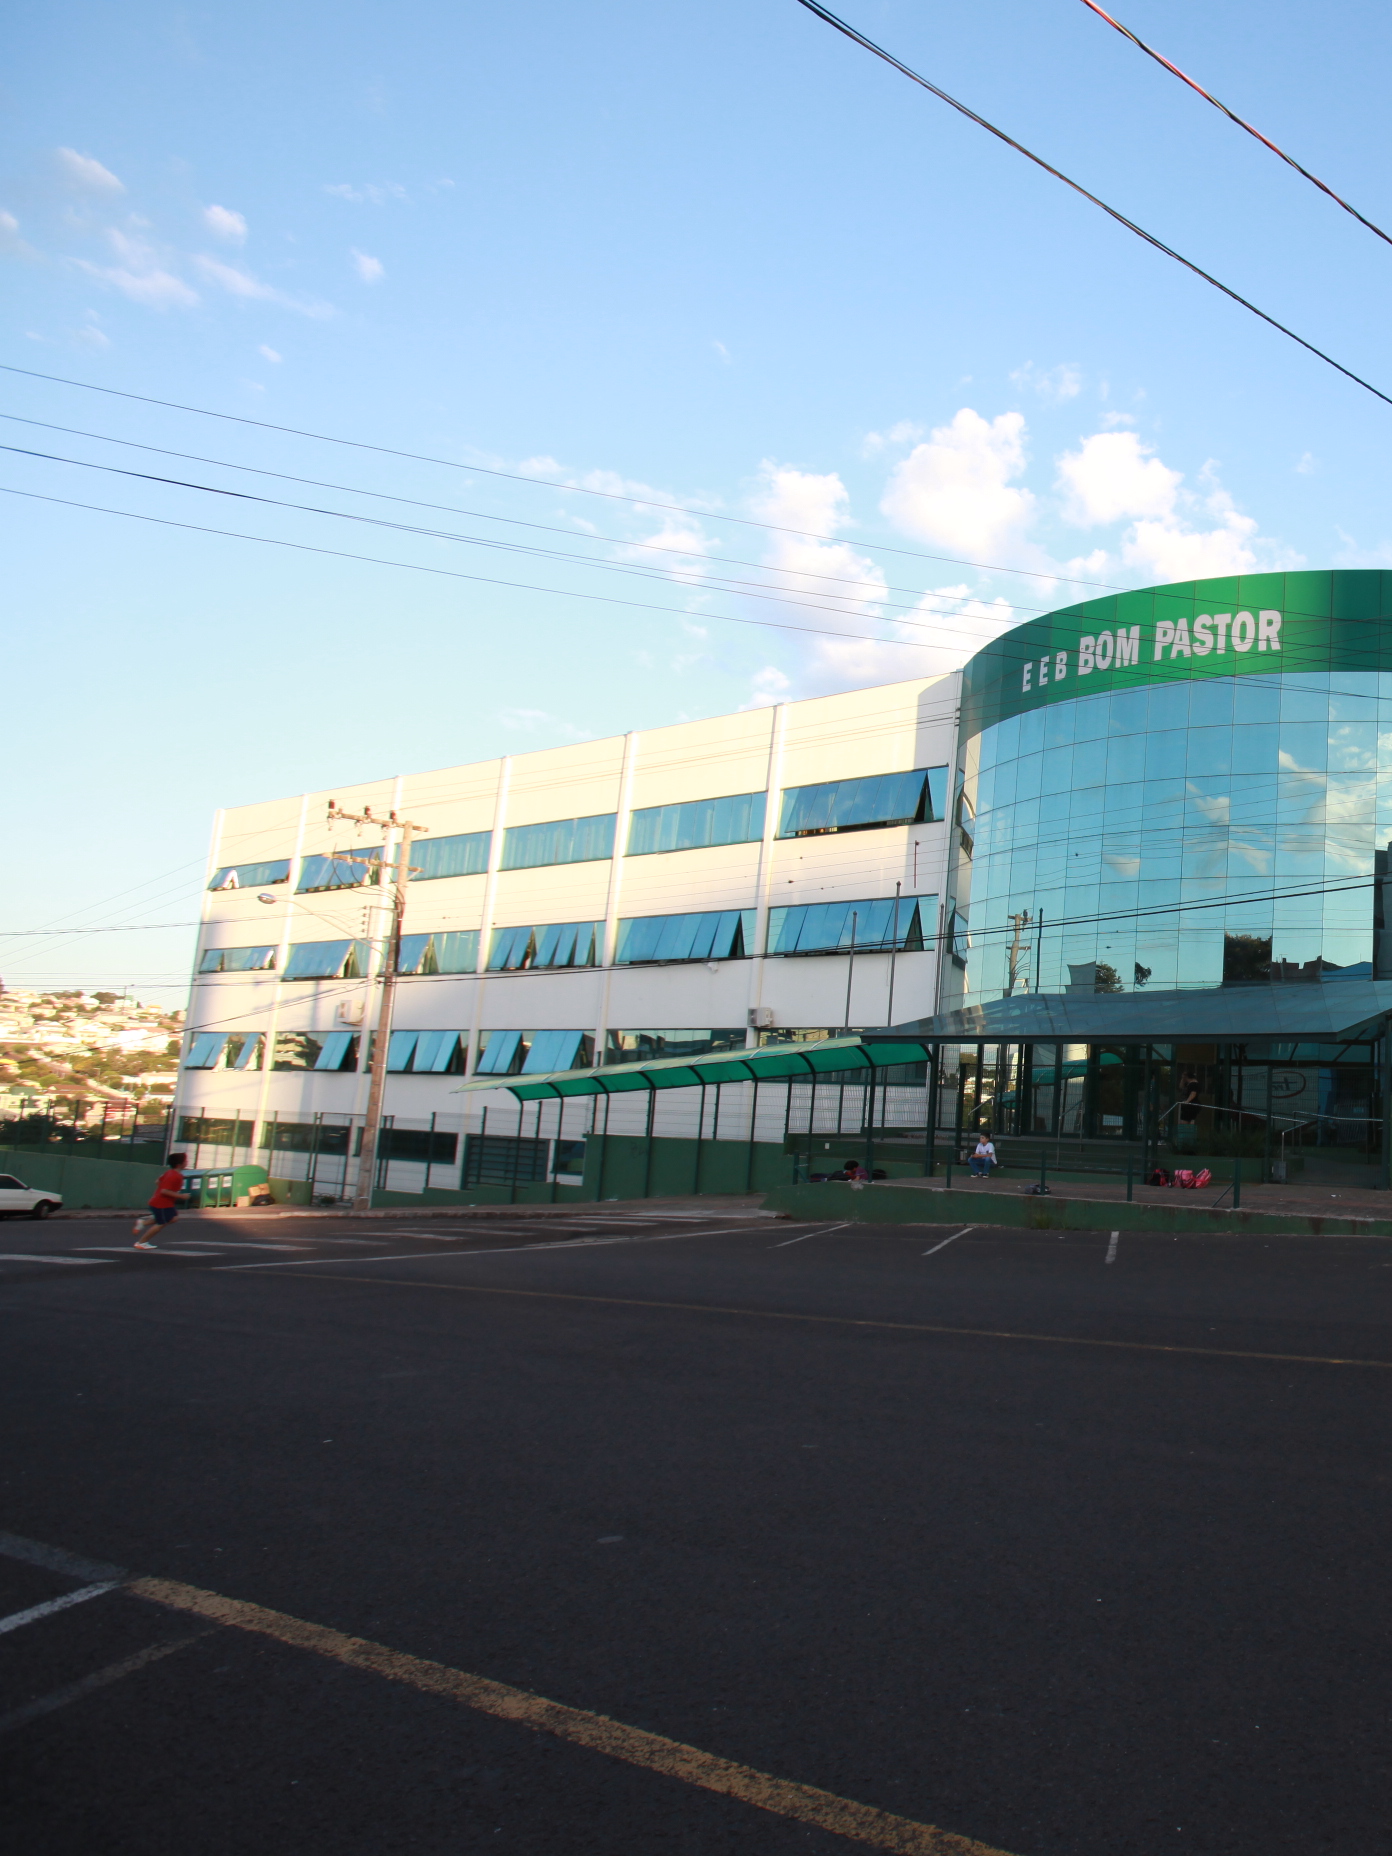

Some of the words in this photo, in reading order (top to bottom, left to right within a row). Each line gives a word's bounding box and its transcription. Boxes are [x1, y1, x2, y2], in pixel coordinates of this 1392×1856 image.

[1022, 662, 1033, 693] E
[1038, 655, 1050, 687] E
[1054, 651, 1068, 682] B
[1077, 625, 1141, 676] BOM
[1153, 610, 1282, 661] PASTOR
